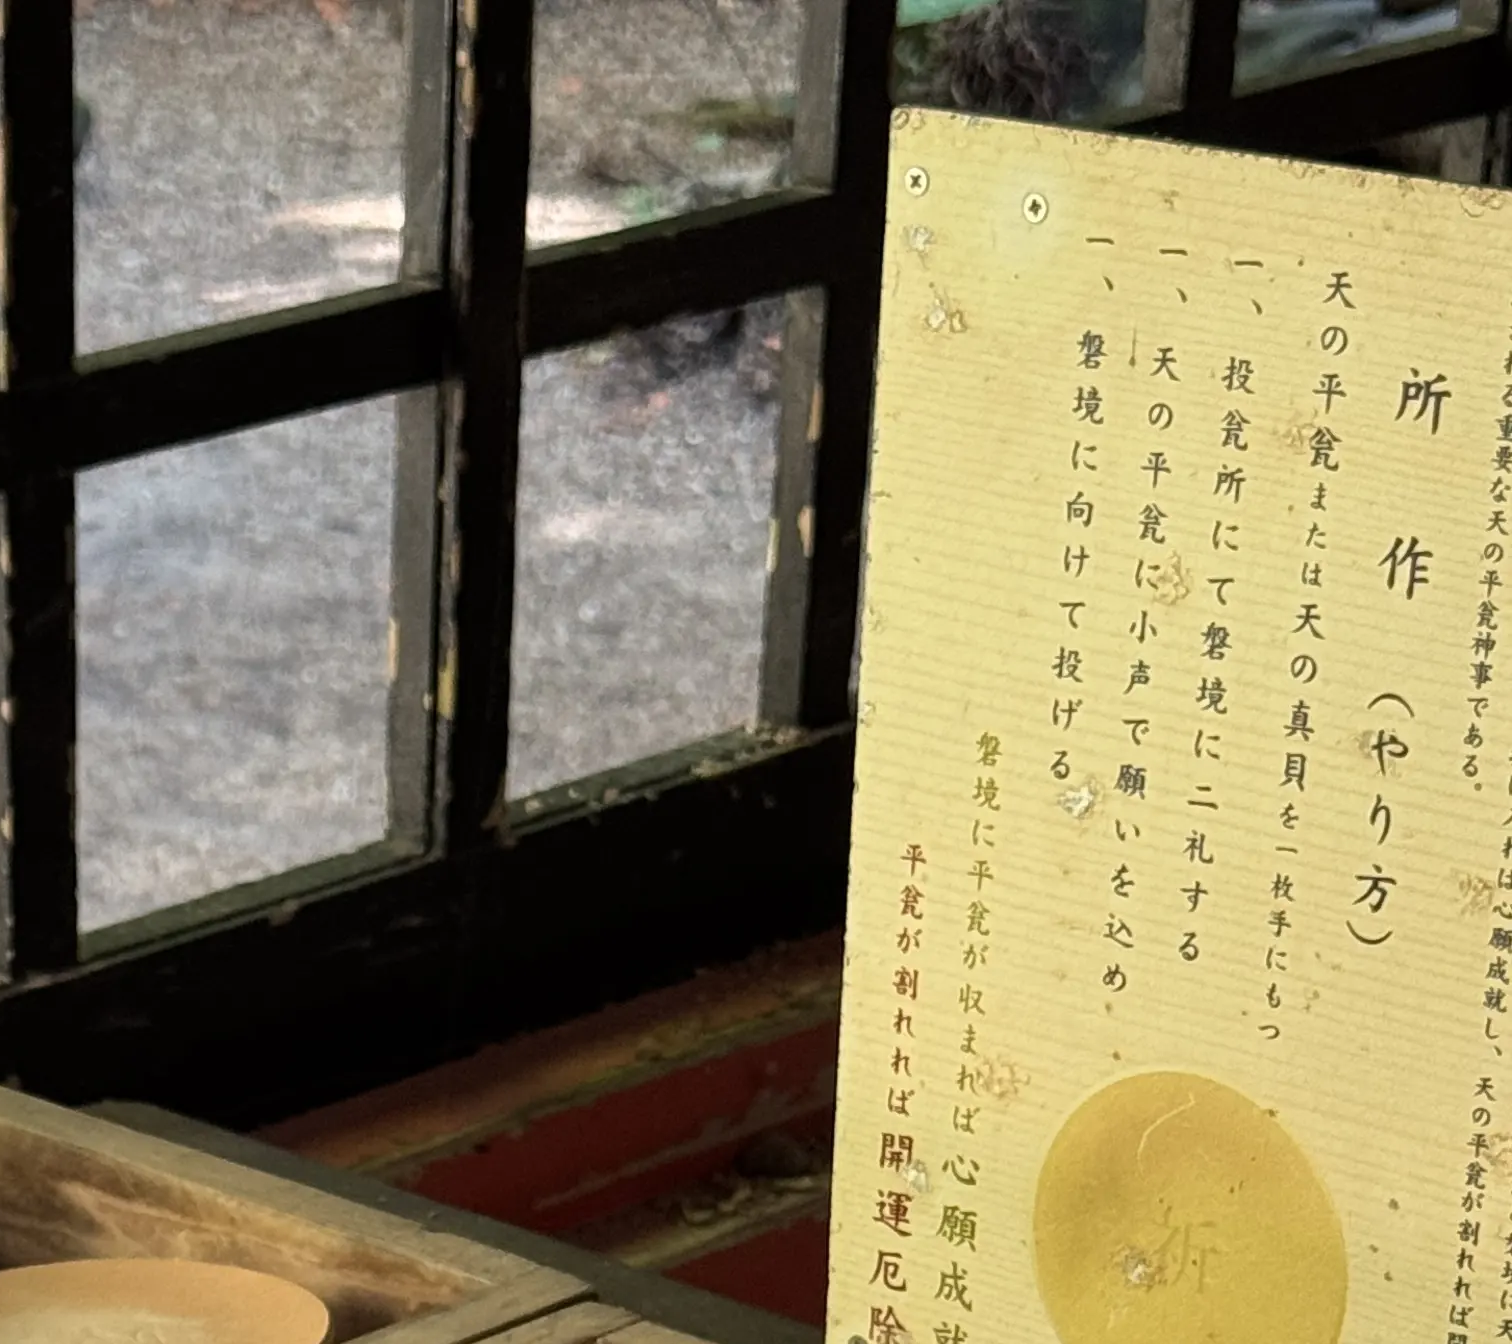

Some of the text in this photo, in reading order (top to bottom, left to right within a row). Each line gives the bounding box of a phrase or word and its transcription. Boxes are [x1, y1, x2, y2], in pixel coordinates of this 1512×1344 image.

[1462, 325, 1512, 792] る重要な天の平瓮神事である。
